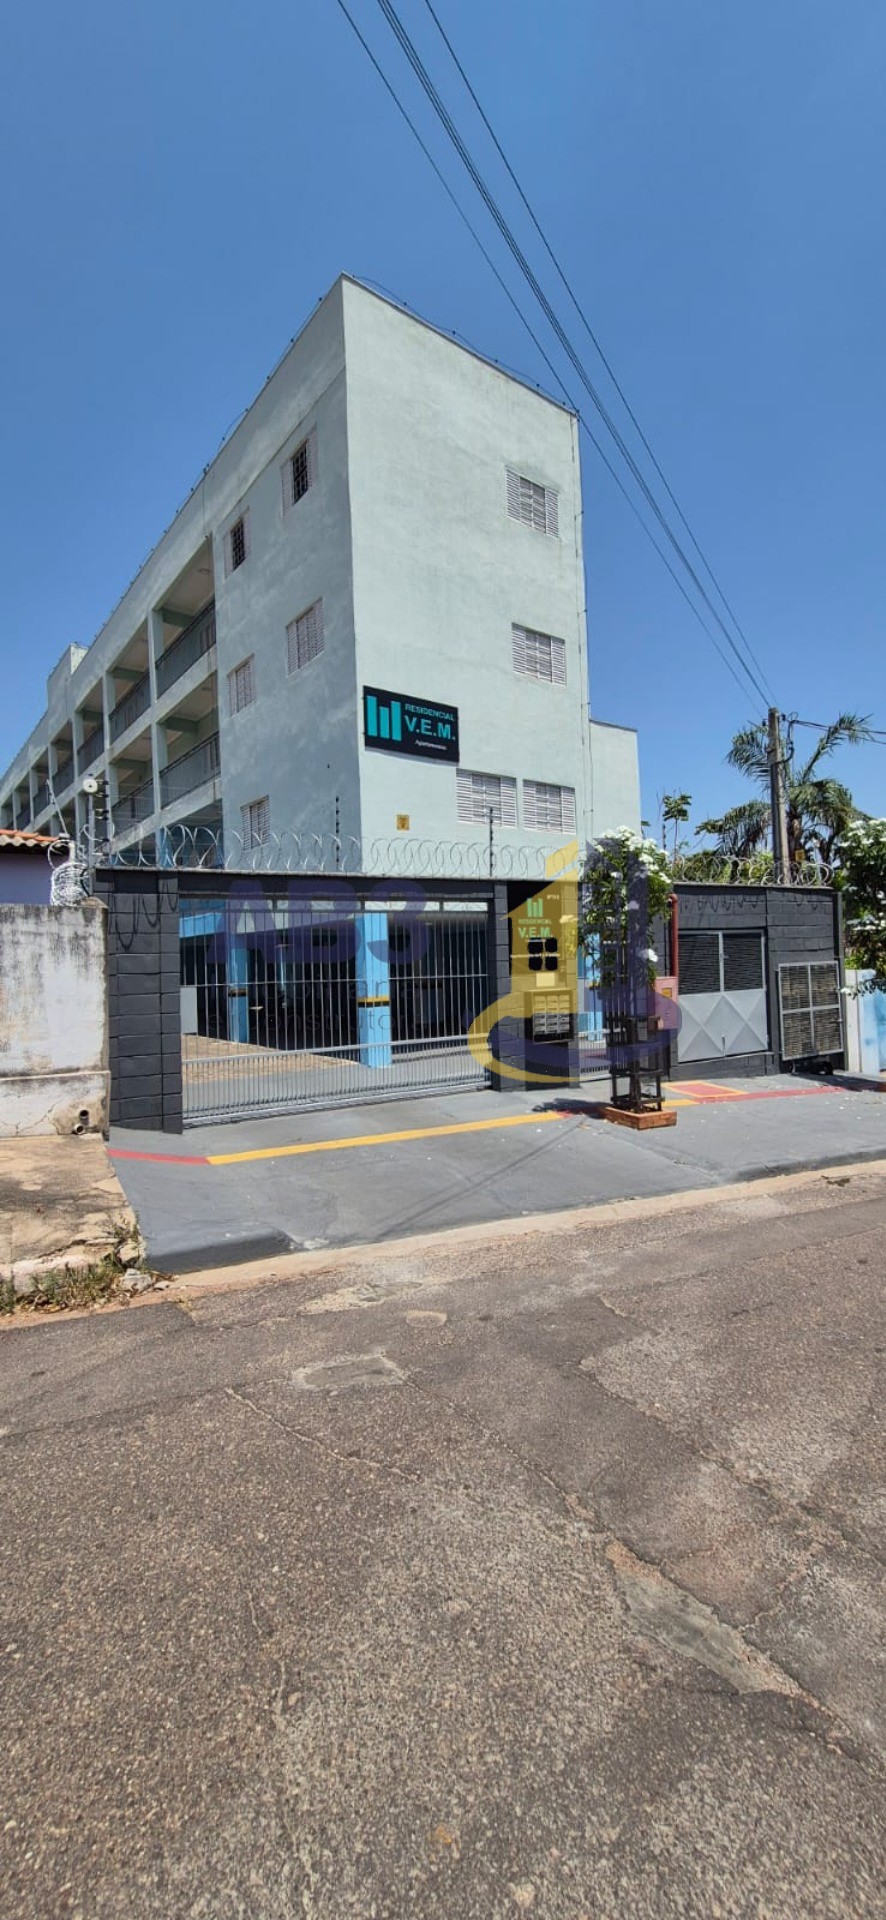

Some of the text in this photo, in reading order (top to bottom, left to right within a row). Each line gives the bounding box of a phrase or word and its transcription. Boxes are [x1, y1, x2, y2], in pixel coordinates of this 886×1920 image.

[405, 703, 454, 721] RESIDENCIAL
[404, 715, 456, 740] V.E.M.
[518, 927, 553, 939] V.E.M.
